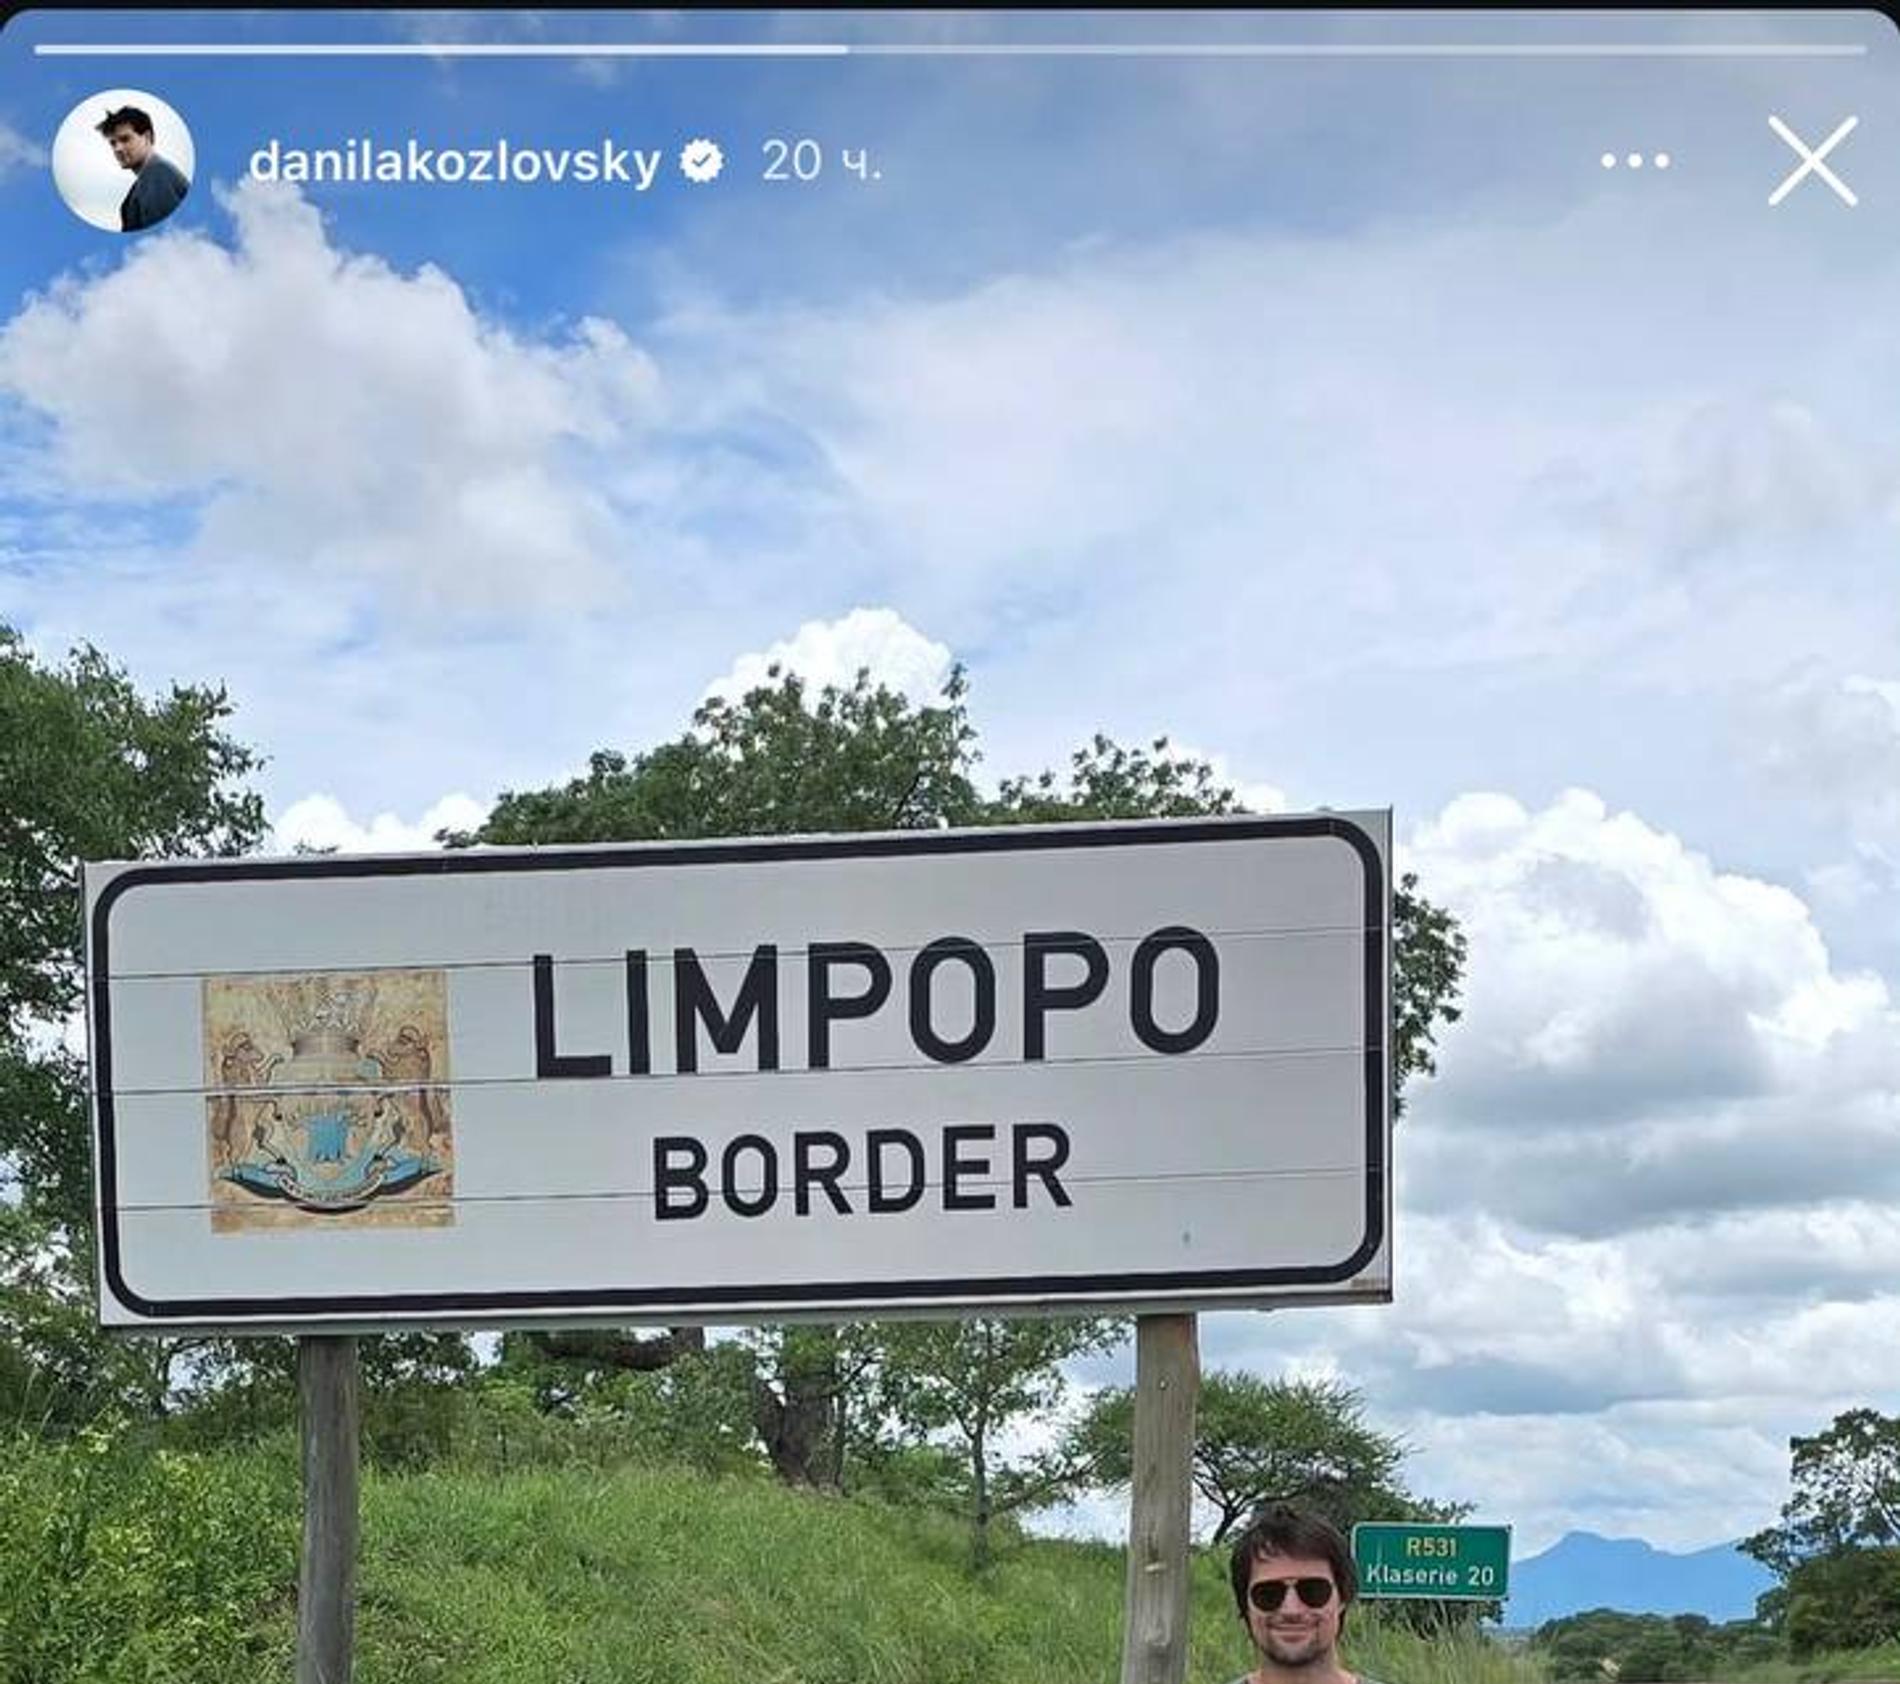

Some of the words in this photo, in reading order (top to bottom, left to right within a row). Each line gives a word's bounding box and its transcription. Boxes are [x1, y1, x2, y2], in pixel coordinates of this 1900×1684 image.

[533, 925, 1220, 1080] LIMPOPO
[652, 1122, 1073, 1221] BORDER
[1365, 1563, 1458, 1586] Klaserie
[1467, 1565, 1494, 1586] 20
[1406, 1536, 1457, 1557] R531
